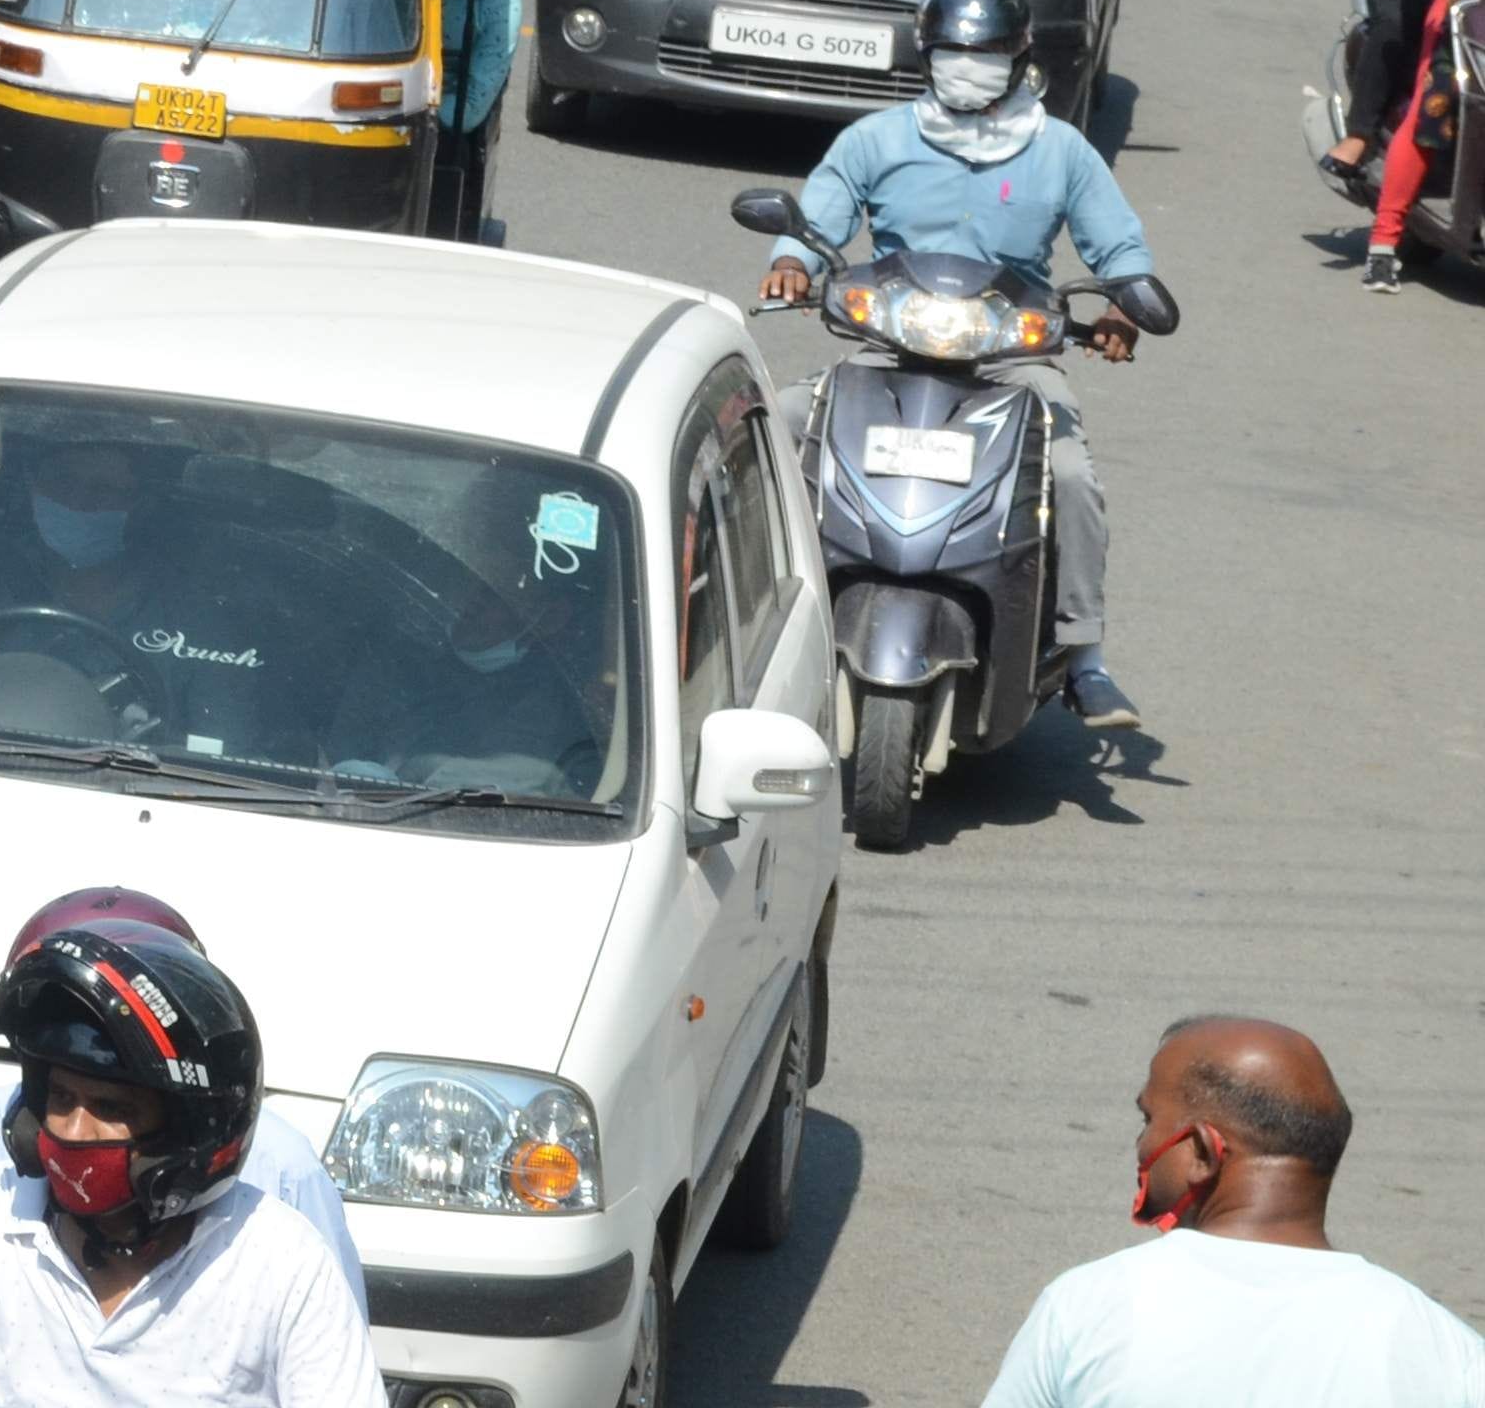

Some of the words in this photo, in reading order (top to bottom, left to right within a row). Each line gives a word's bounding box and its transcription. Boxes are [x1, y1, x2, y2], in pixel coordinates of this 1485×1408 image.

[724, 25, 786, 48] UK04
[796, 33, 815, 51] G
[823, 36, 879, 58] 5078
[155, 173, 190, 198] RE
[133, 608, 265, 669] Arush
